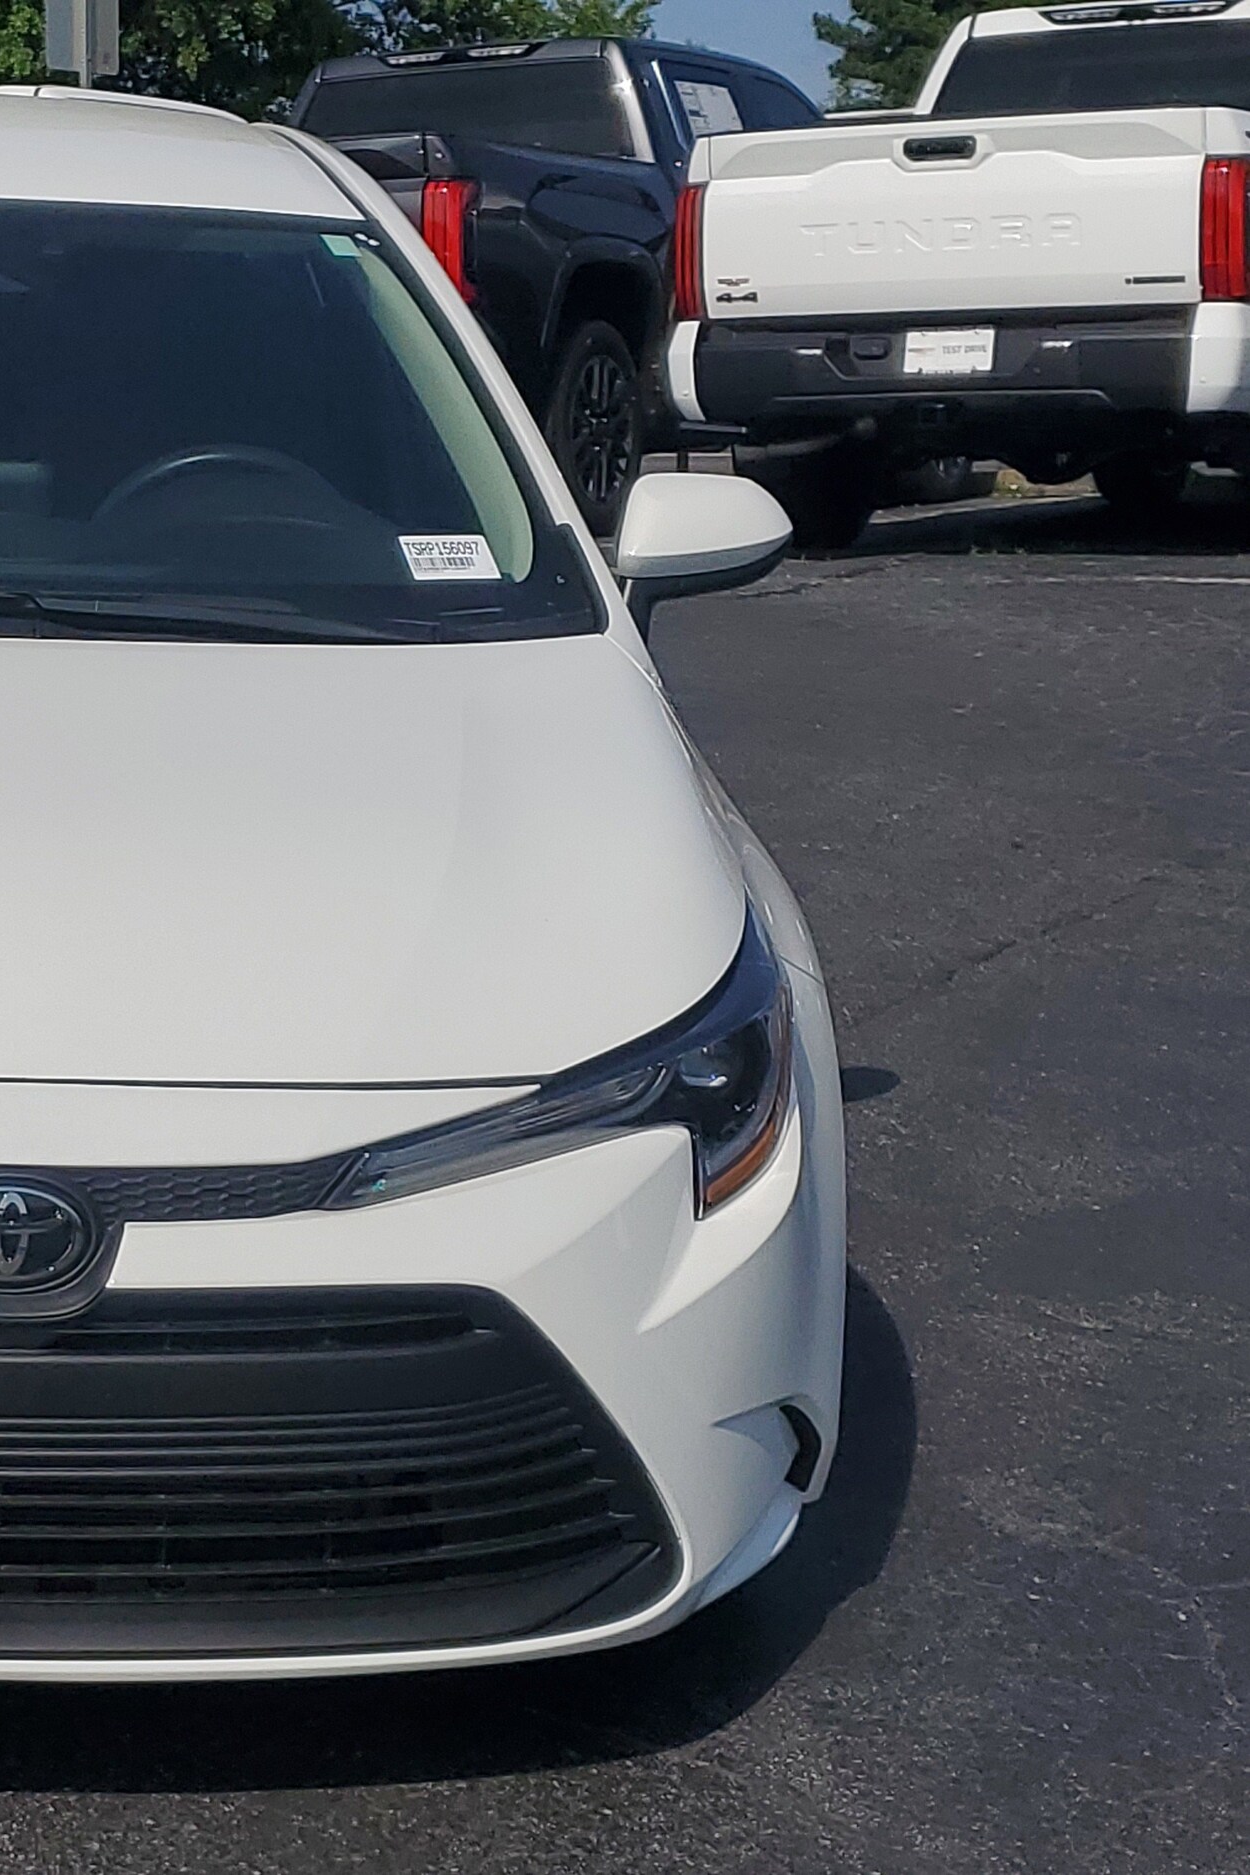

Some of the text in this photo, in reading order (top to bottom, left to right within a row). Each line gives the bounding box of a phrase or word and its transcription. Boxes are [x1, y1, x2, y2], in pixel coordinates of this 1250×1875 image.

[799, 212, 1082, 257] TUNDRA
[941, 344, 963, 354] TEST
[403, 541, 480, 556] TSRP156097
